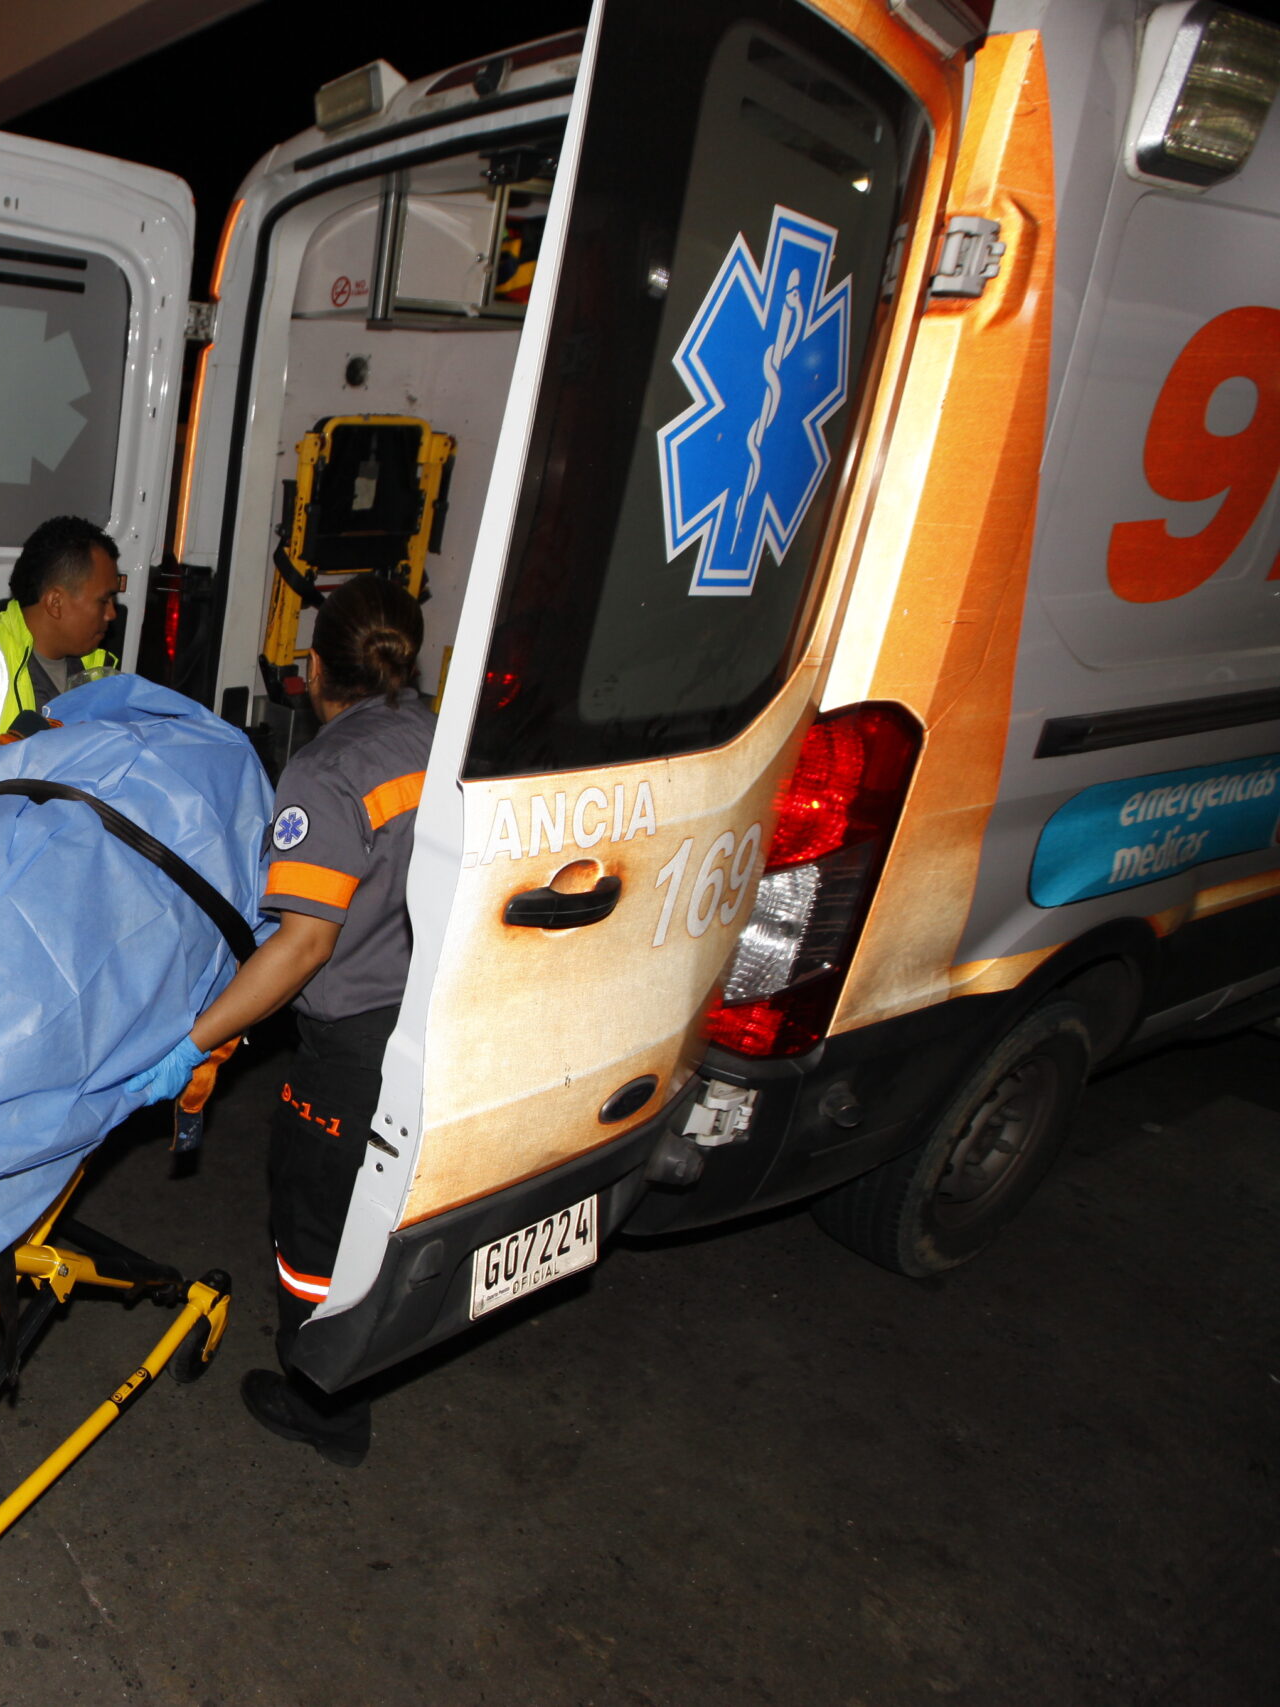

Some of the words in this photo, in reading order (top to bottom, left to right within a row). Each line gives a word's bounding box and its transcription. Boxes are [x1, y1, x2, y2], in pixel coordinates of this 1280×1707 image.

[1107, 305, 1280, 603] 9
[463, 781, 656, 868] ANCIA
[1119, 760, 1280, 826] emergencias
[651, 822, 762, 948] 169
[512, 1261, 560, 1294] OFICIAL
